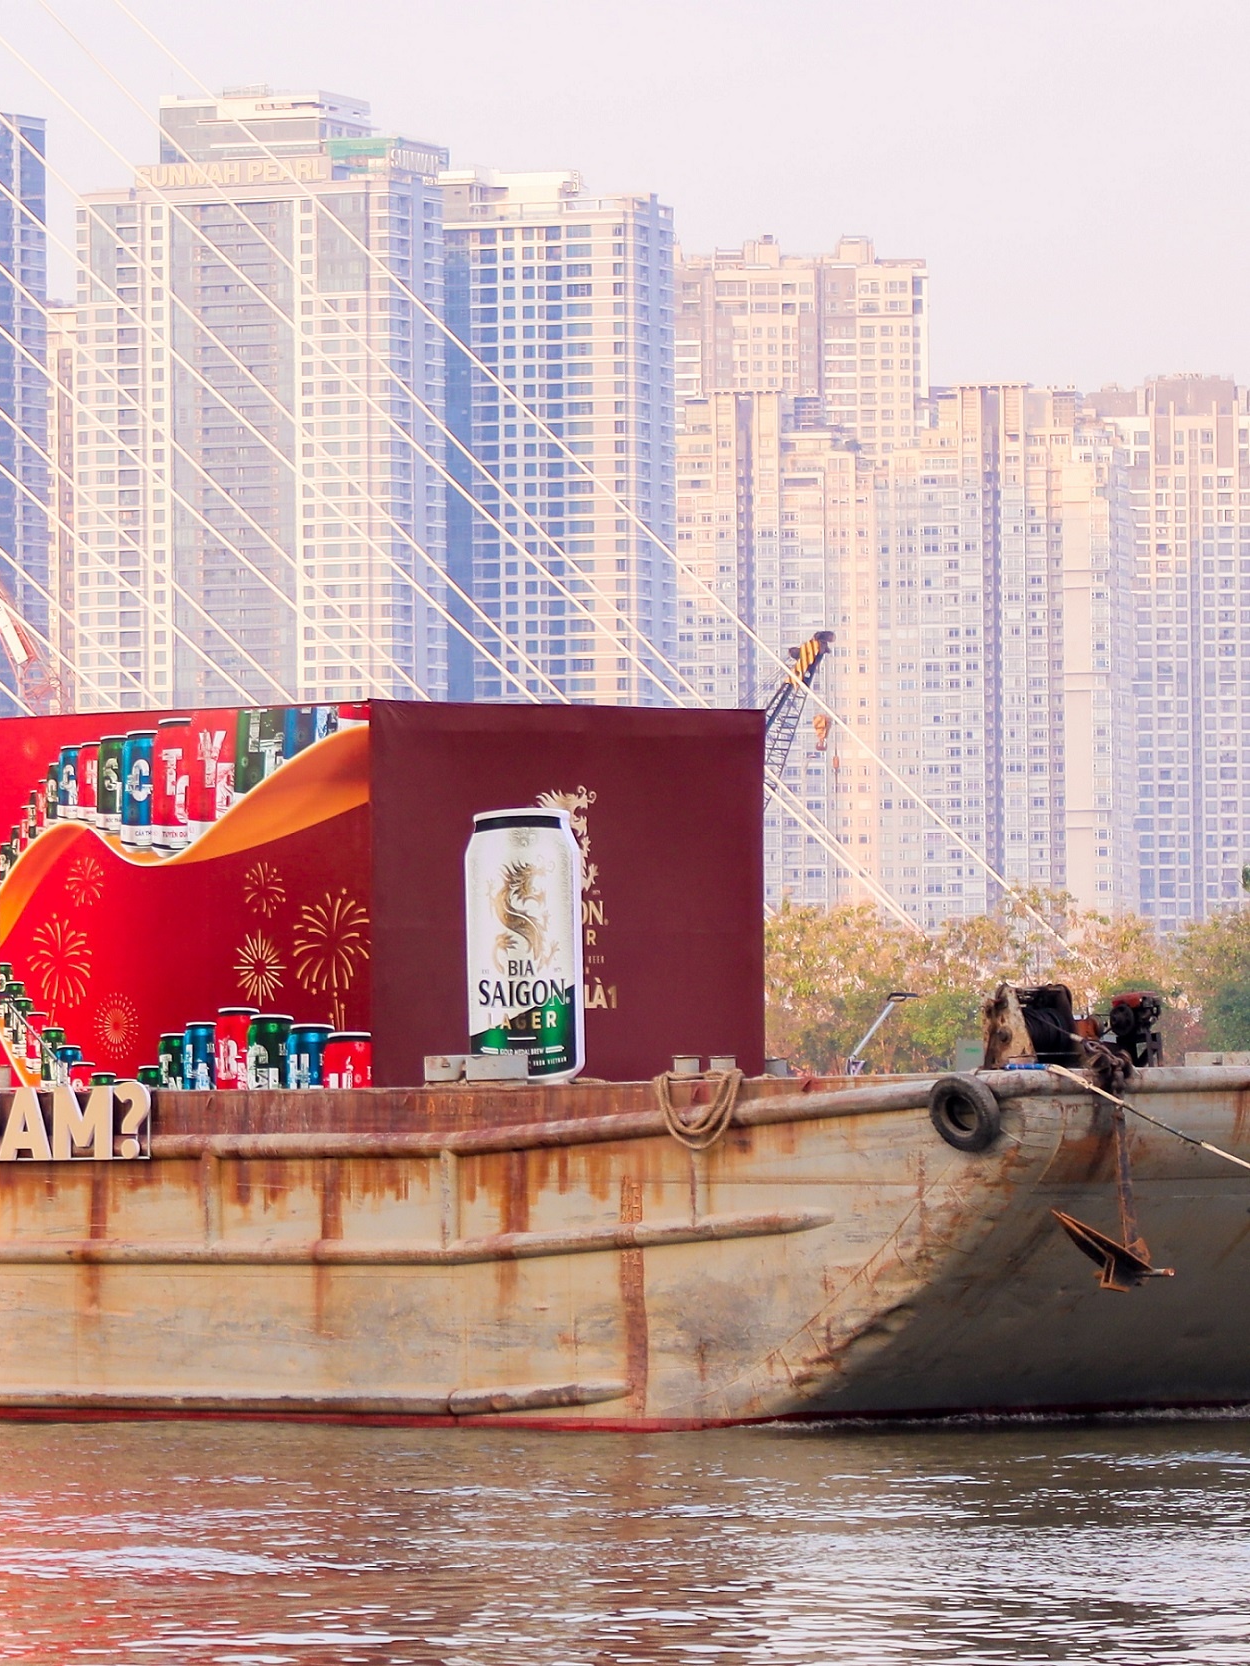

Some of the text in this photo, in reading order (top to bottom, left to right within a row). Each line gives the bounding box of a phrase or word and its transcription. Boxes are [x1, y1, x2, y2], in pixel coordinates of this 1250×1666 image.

[134, 157, 328, 189] SUNWAH PEARL
[508, 959, 535, 977] BIA
[478, 978, 566, 1008] SAIGON
[584, 976, 618, 1009] LÀ1
[488, 1010, 558, 1031] LAGER
